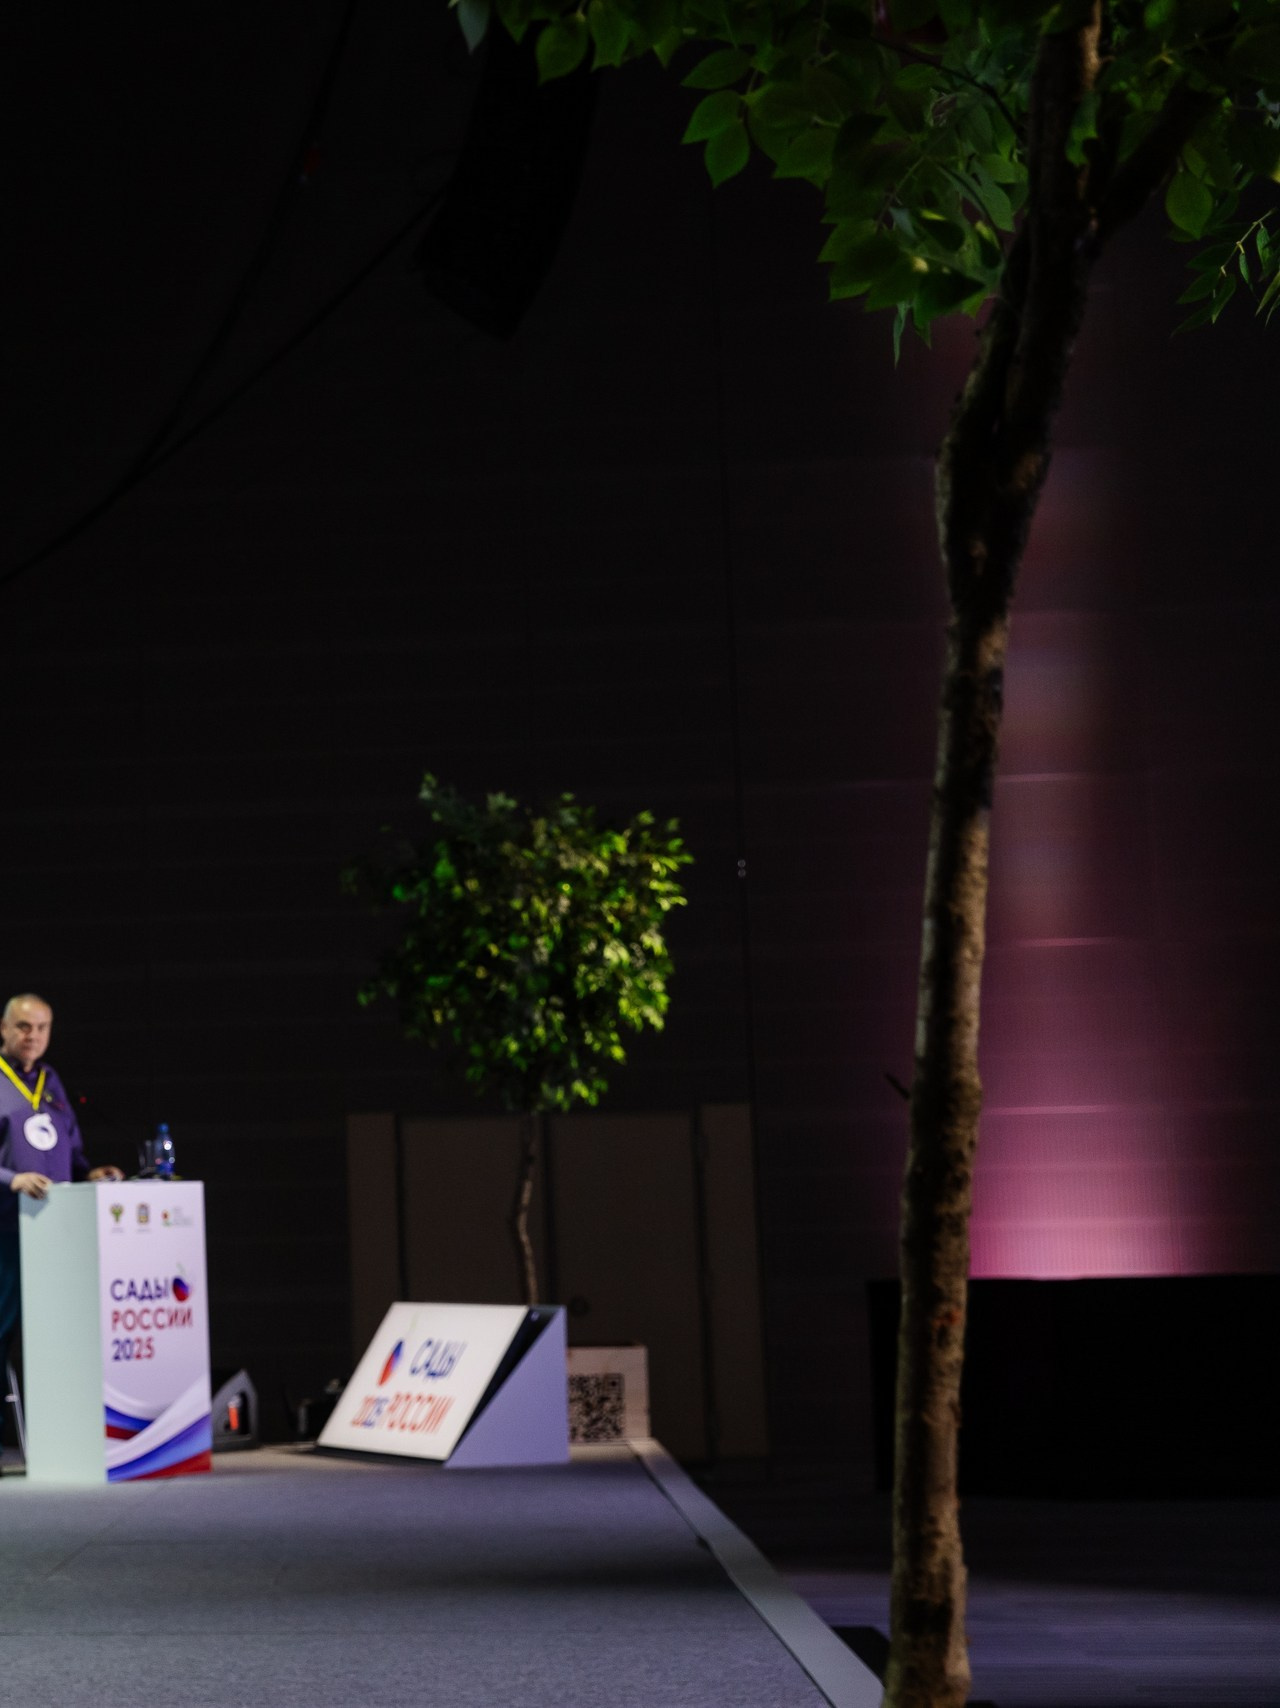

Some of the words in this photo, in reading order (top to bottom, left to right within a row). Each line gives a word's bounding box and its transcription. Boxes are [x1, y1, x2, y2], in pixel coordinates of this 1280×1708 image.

[110, 1278, 169, 1302] САДЫ
[111, 1307, 193, 1332] РОССИИ
[111, 1338, 155, 1362] 2025
[409, 1338, 467, 1381] САДЫ
[387, 1393, 455, 1433] РОССИИ
